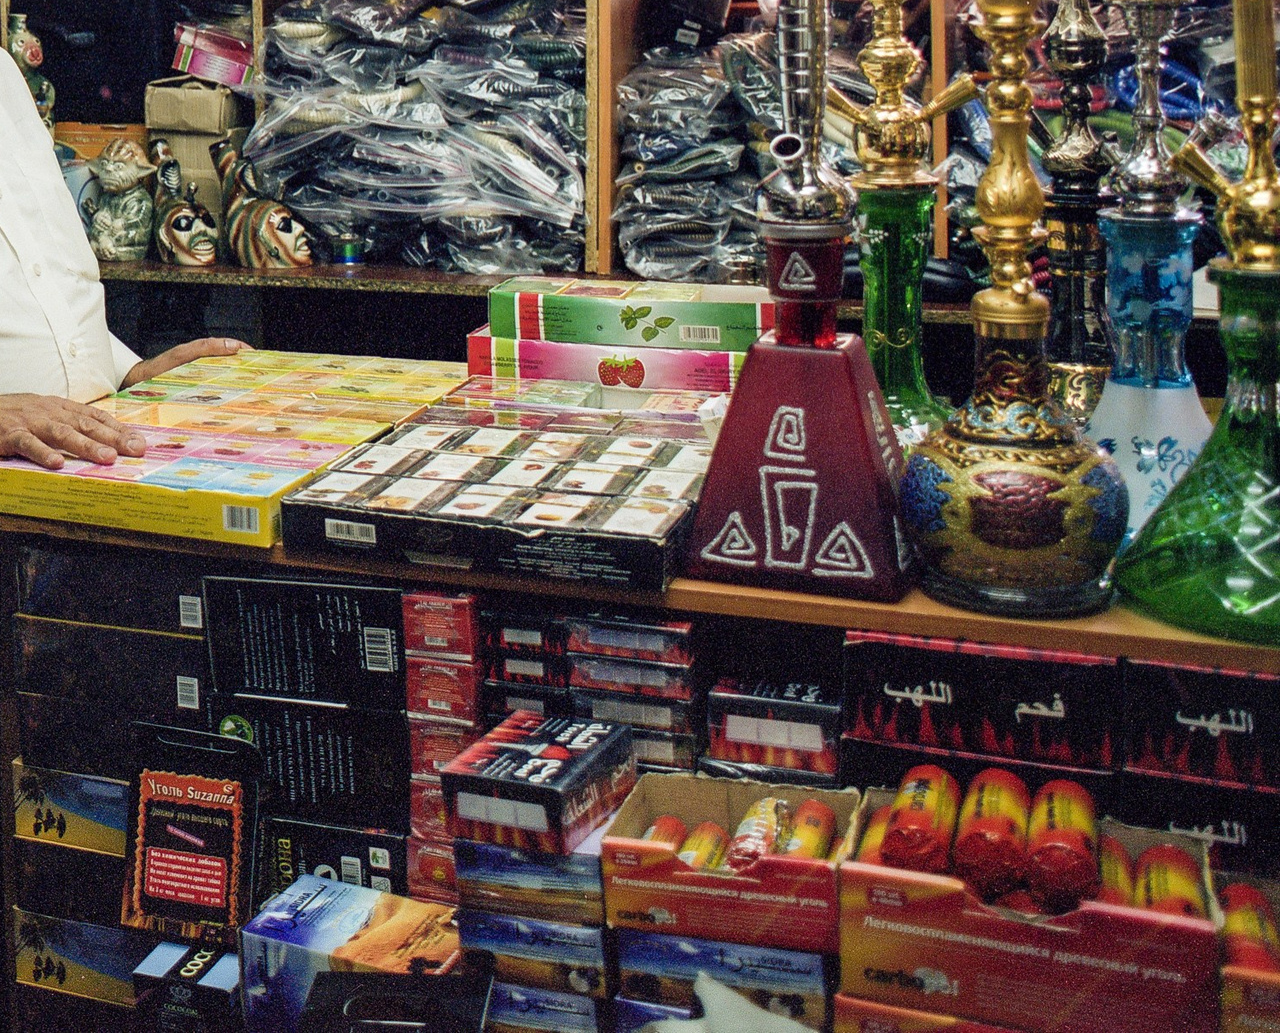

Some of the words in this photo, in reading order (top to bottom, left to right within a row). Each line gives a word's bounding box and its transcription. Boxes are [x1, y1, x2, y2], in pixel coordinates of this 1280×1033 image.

[883, 680, 953, 706] اللهب
[1015, 692, 1065, 723] فحم
[1175, 708, 1254, 737] اللهب
[148, 778, 183, 798] Уголь
[187, 786, 235, 805] Suzanna
[150, 849, 161, 858] Без
